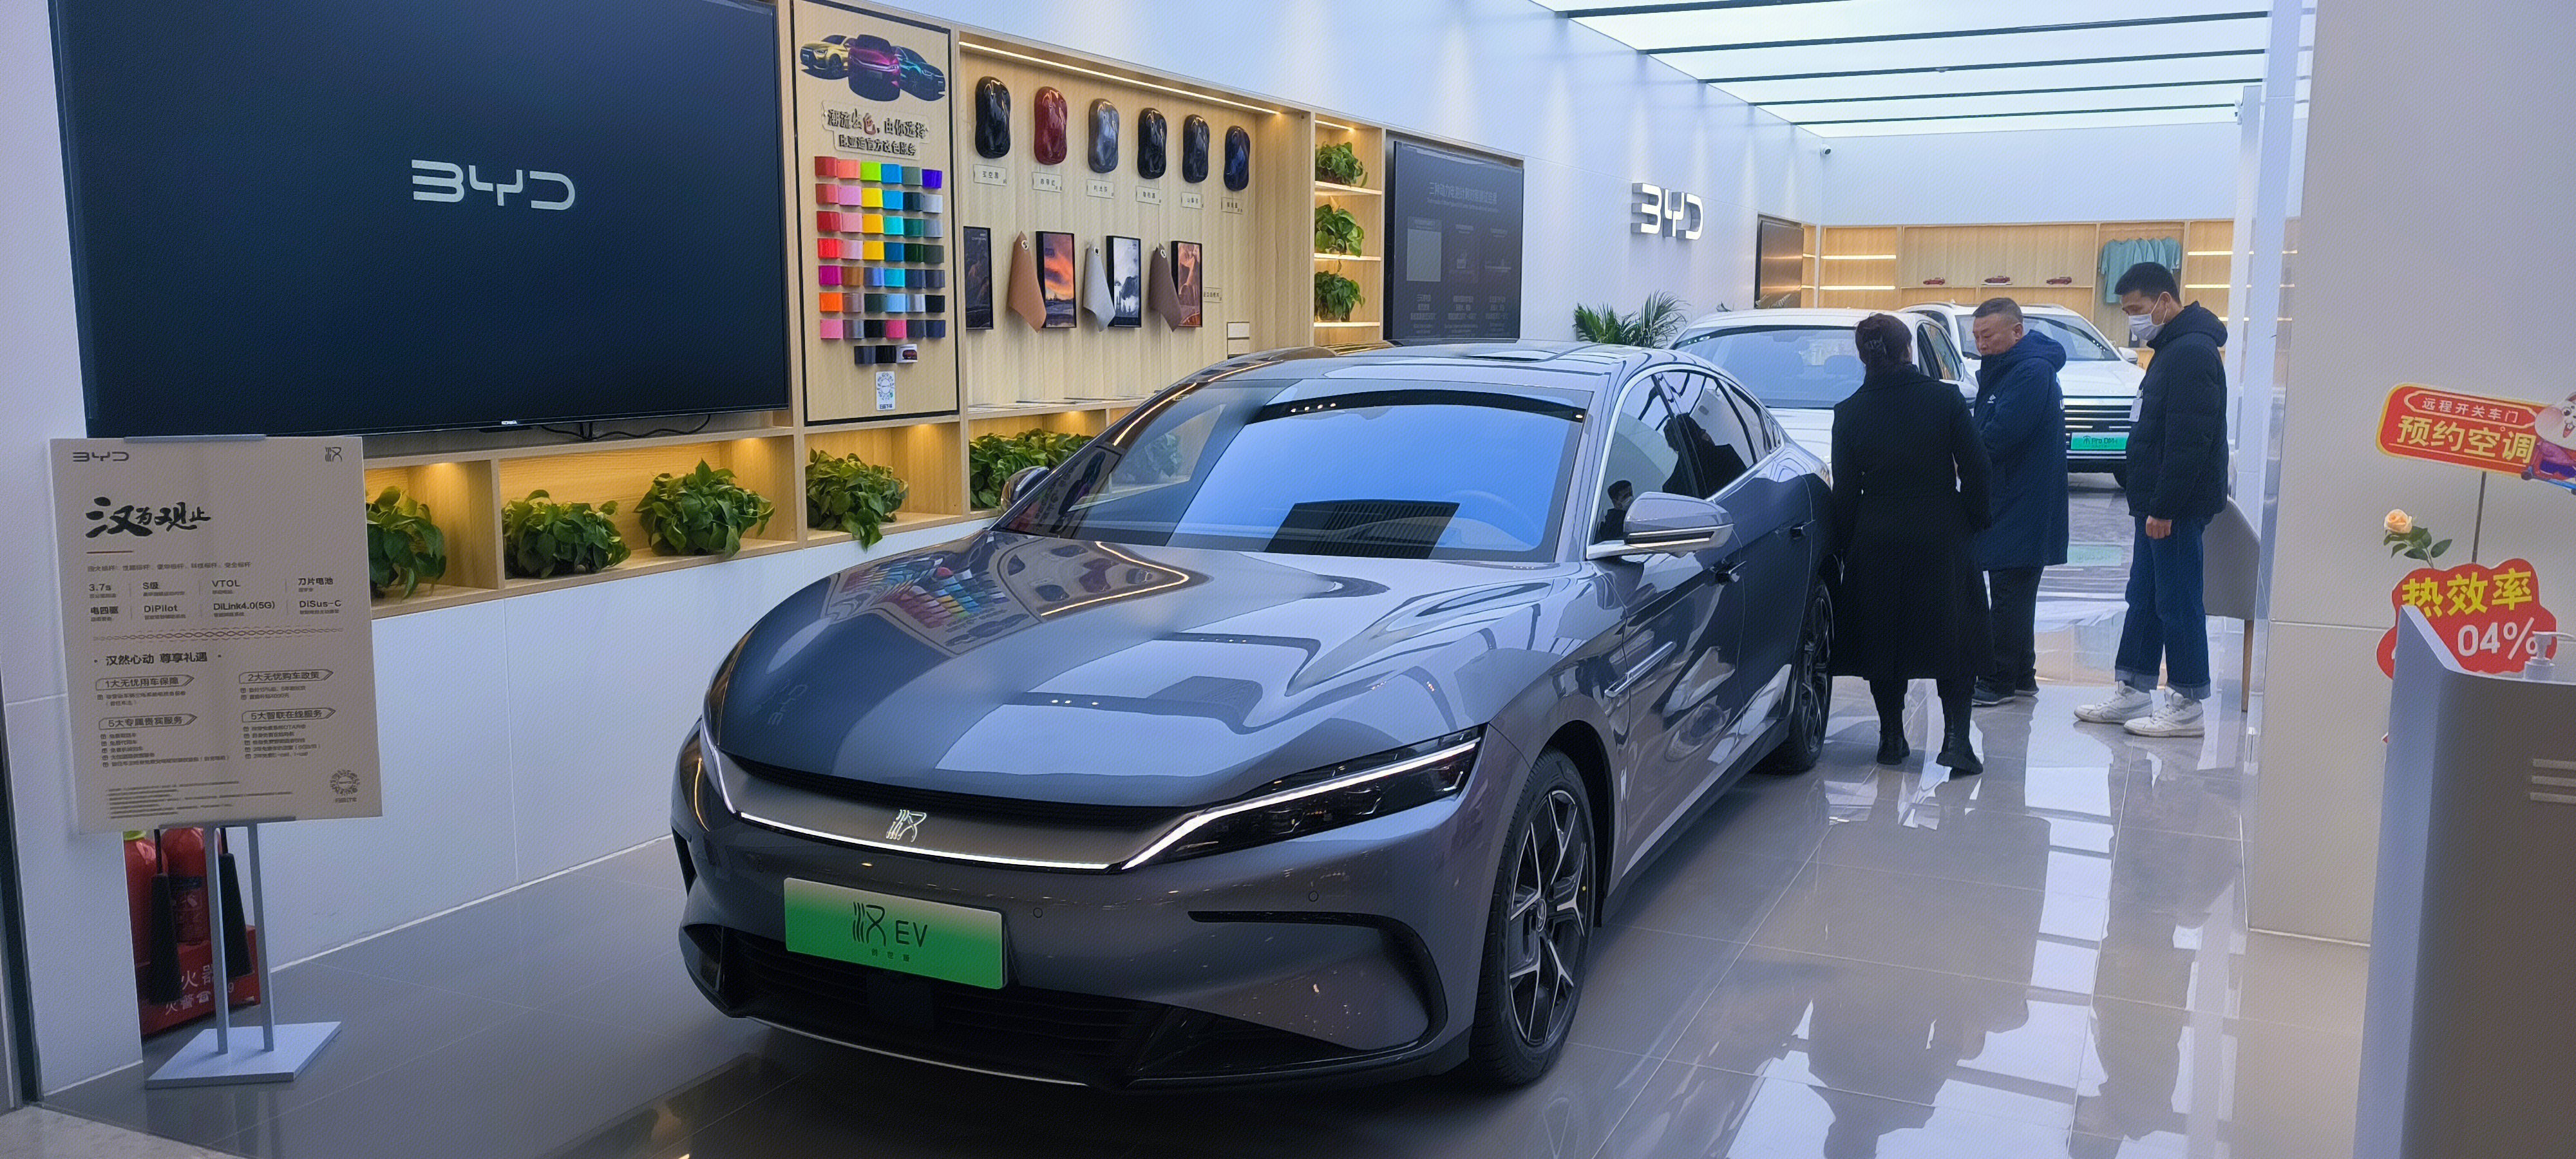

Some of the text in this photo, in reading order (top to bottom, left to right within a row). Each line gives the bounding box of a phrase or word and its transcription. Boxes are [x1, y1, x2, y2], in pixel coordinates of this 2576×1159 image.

[412, 159, 575, 211] BYD
[1631, 182, 1703, 240] BYD
[2421, 397, 2519, 424] 远程开关车门
[2396, 415, 2536, 463] 预约空调
[73, 451, 129, 462] BYD
[86, 496, 211, 538] 汉为观止
[142, 581, 159, 590] S级
[212, 580, 241, 588] VTOL
[298, 577, 334, 586] 刀片电池
[89, 583, 111, 592] 3.7s
[2402, 568, 2532, 617] 热效率
[144, 604, 178, 614] DiPilot
[213, 601, 276, 611] DiLink4.0(5G)
[299, 599, 342, 608] DiSus-C
[90, 605, 118, 615] 电四驱
[106, 652, 208, 666] 汉然心动 尊享礼遇
[105, 677, 179, 688] 1大无忧用车保障
[248, 672, 320, 682] 2大无忧购车政策
[251, 710, 323, 721] 5大智联在线服务
[108, 716, 183, 728] 5大专属贵宾服务
[895, 919, 929, 947] EV
